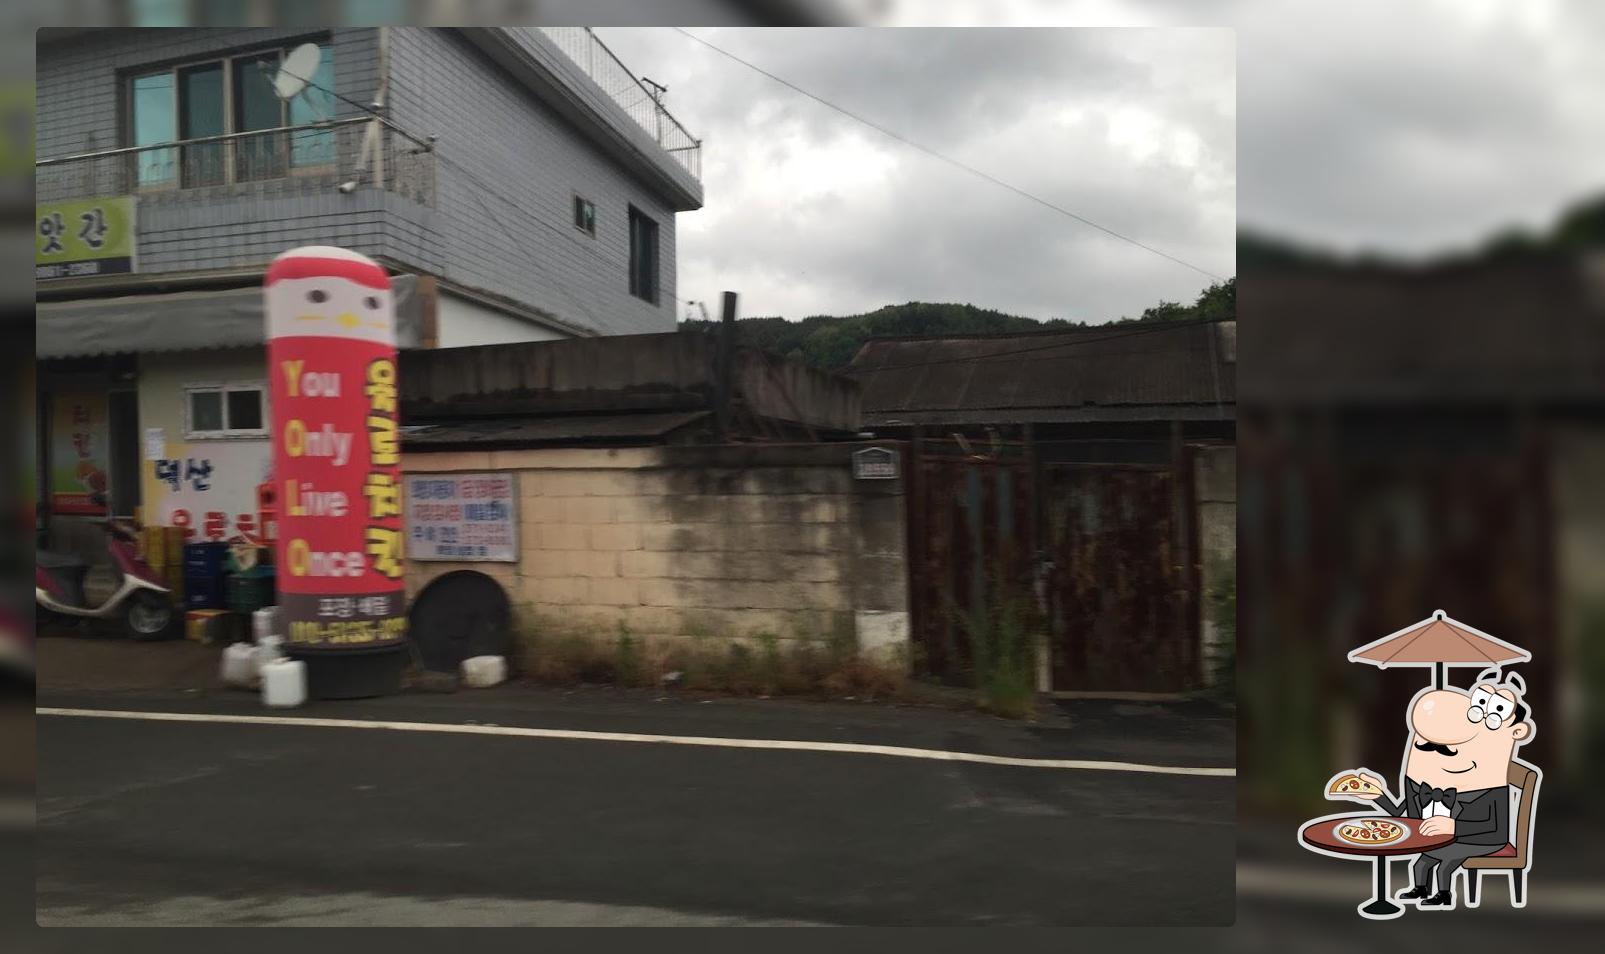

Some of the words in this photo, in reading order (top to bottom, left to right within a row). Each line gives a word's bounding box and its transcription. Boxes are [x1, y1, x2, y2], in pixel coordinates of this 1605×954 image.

[280, 359, 341, 398] You
[284, 419, 353, 466] Only
[285, 479, 349, 517] Live
[287, 538, 366, 577] Once
